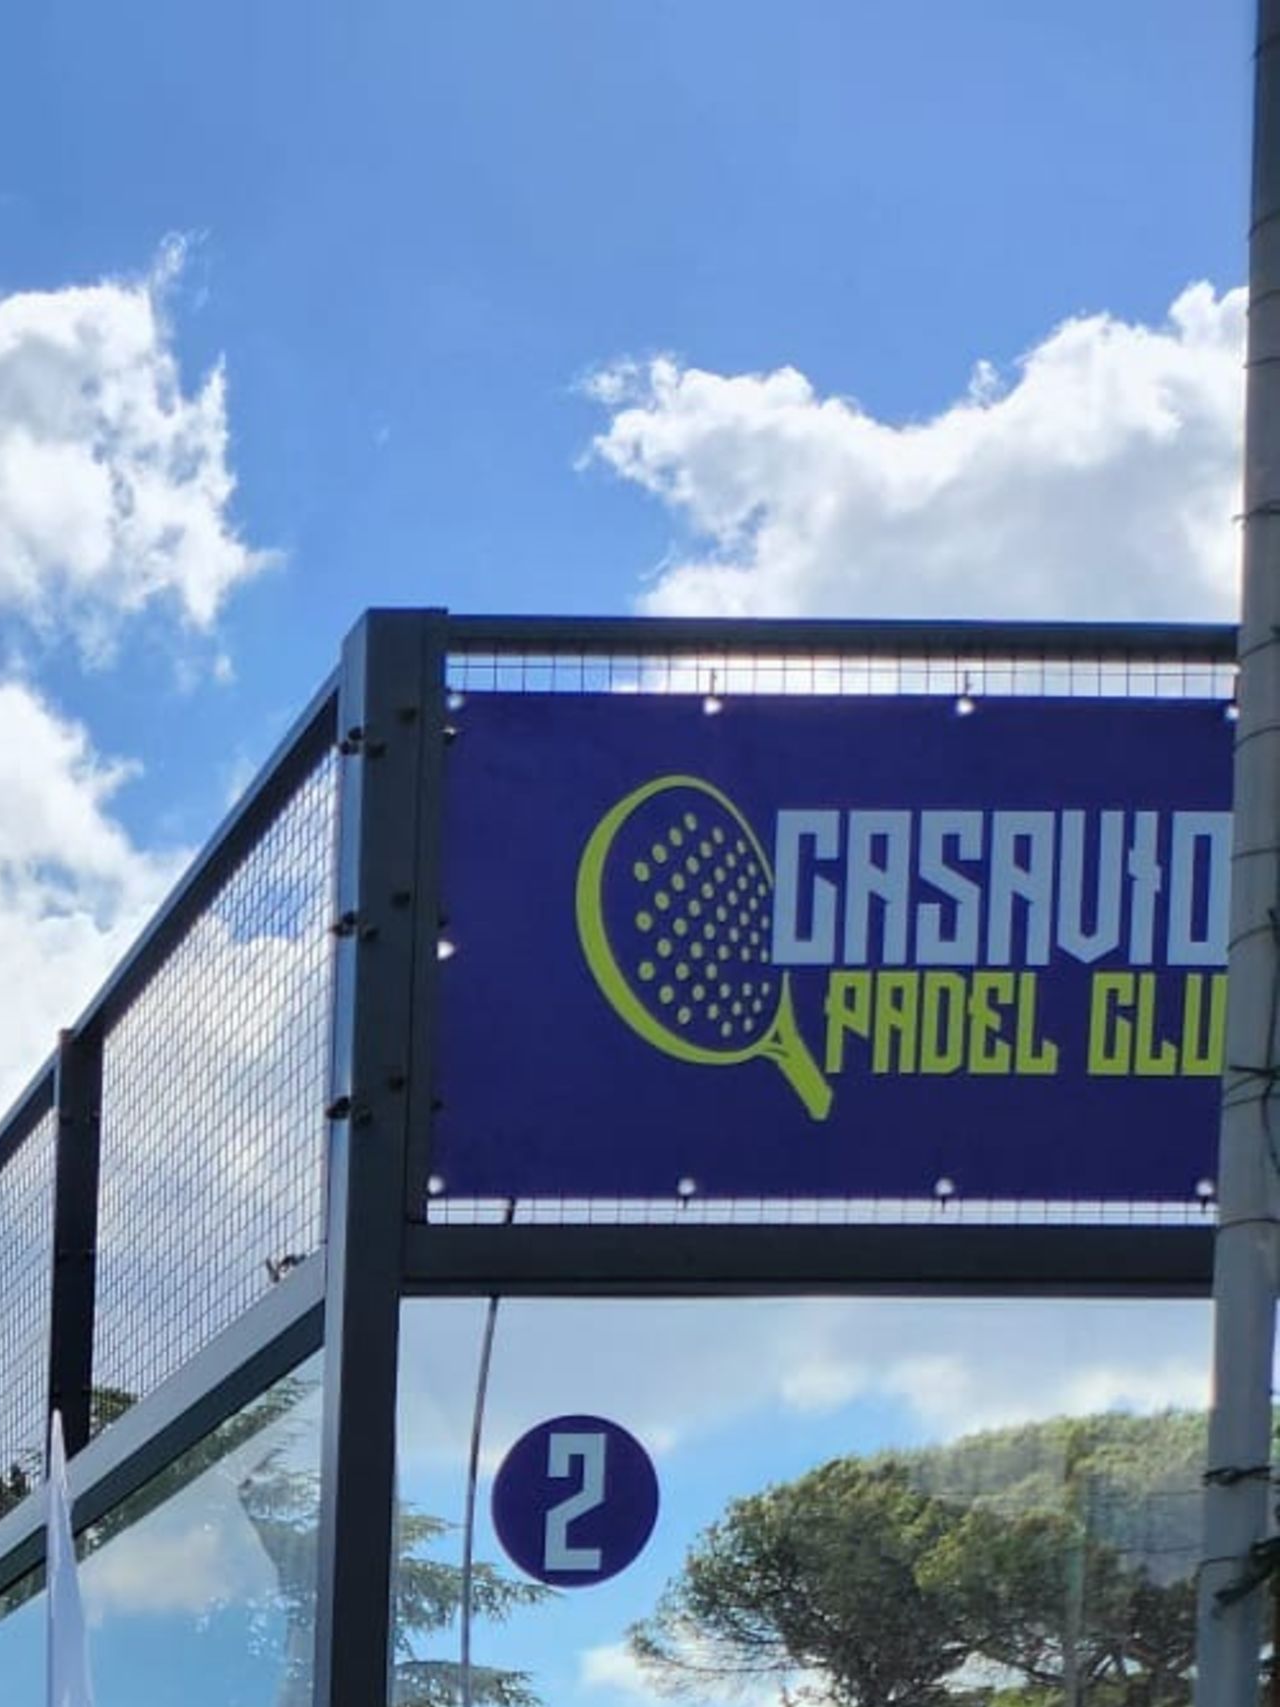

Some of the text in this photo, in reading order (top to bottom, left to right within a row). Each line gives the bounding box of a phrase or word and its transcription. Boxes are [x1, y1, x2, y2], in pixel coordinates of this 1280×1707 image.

[824, 971, 1229, 1077] PADEL CLU
[544, 1432, 607, 1571] 2
